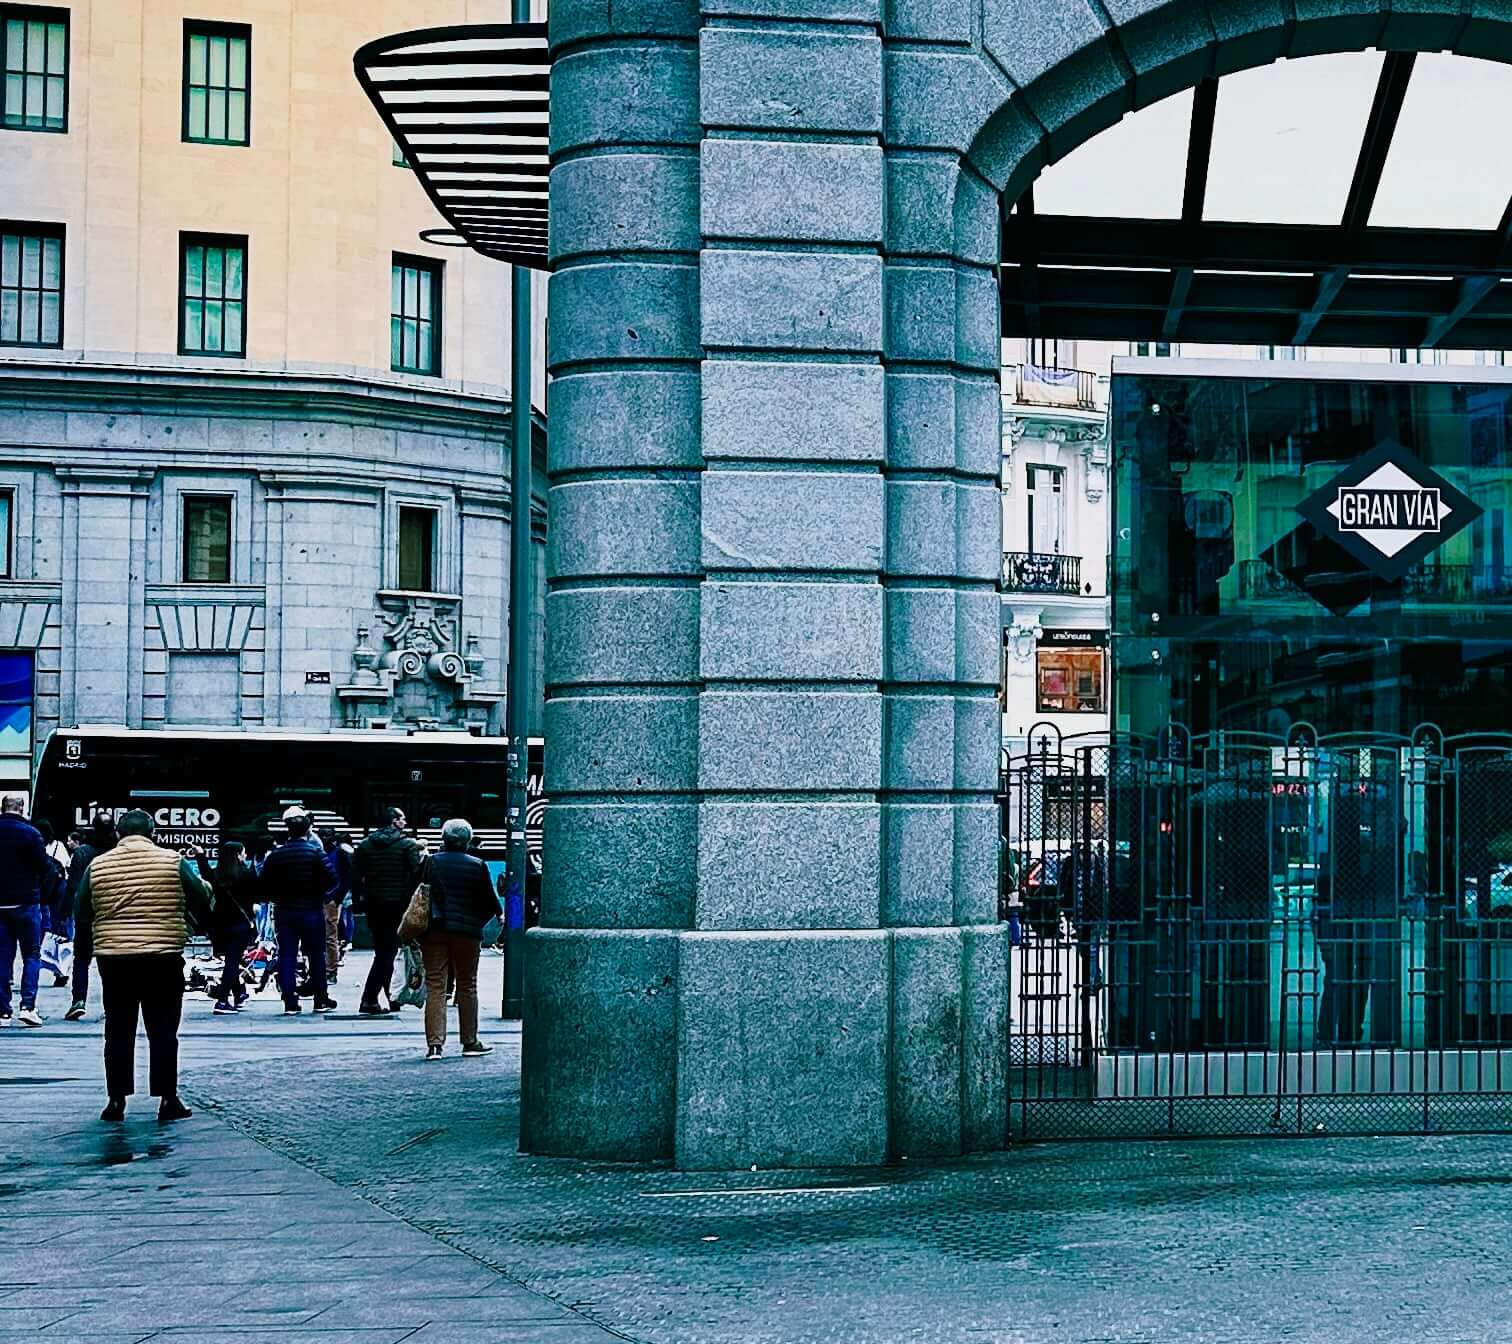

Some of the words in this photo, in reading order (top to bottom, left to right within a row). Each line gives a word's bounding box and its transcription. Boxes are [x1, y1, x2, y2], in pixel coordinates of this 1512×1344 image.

[1342, 493, 1398, 525] GRAN
[1403, 490, 1436, 526] VÍA
[154, 808, 221, 827] CERO
[151, 833, 220, 844] MISIONES
[179, 847, 219, 858] COTE
